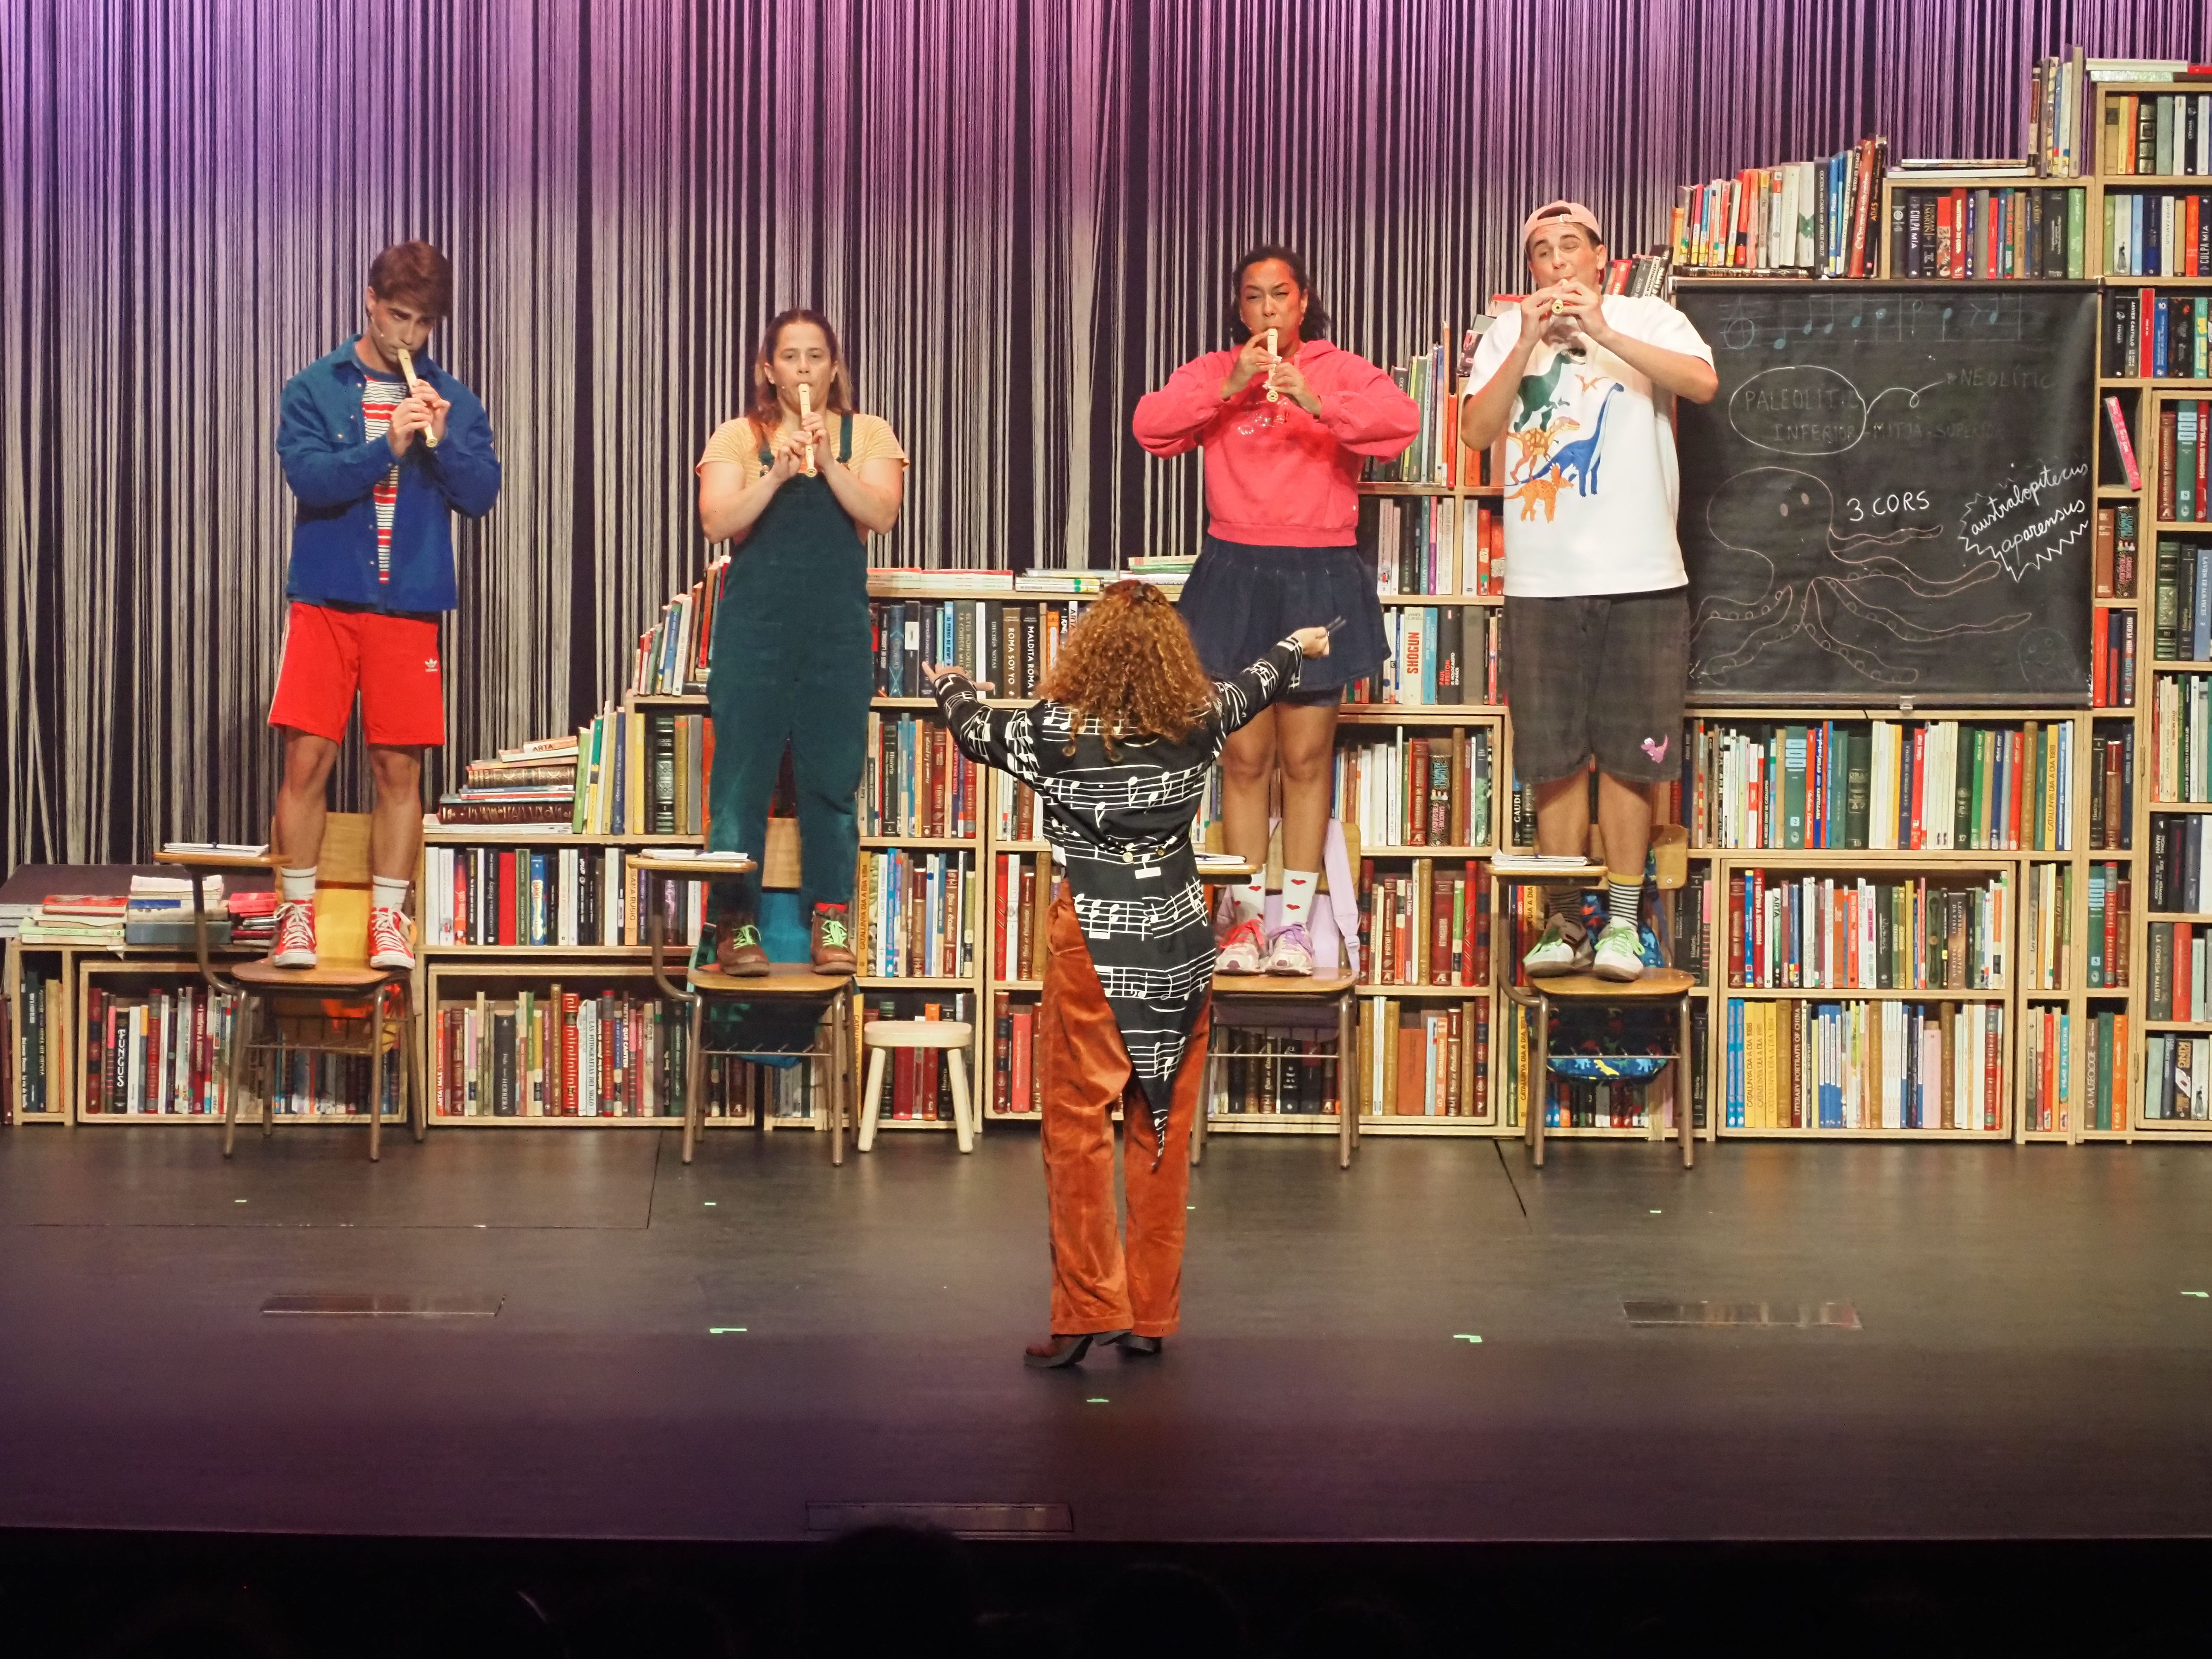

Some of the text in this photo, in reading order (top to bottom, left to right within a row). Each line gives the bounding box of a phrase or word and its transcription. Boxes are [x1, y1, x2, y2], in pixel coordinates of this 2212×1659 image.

[1910, 211, 1920, 249] CULPA MÍA
[2200, 243, 2209, 263] CULPA
[1873, 491, 1930, 515] CORS
[1971, 463, 2088, 535] australopitecus
[2001, 499, 2085, 567] aparensus
[1008, 673, 1014, 685] YO
[532, 743, 554, 752] ARTA
[859, 881, 867, 891] DIA
[859, 899, 867, 910] DIA
[859, 912, 867, 949] CATALUNYA
[1794, 1033, 1801, 1042] OF
[2178, 1042, 2187, 1068] KING
